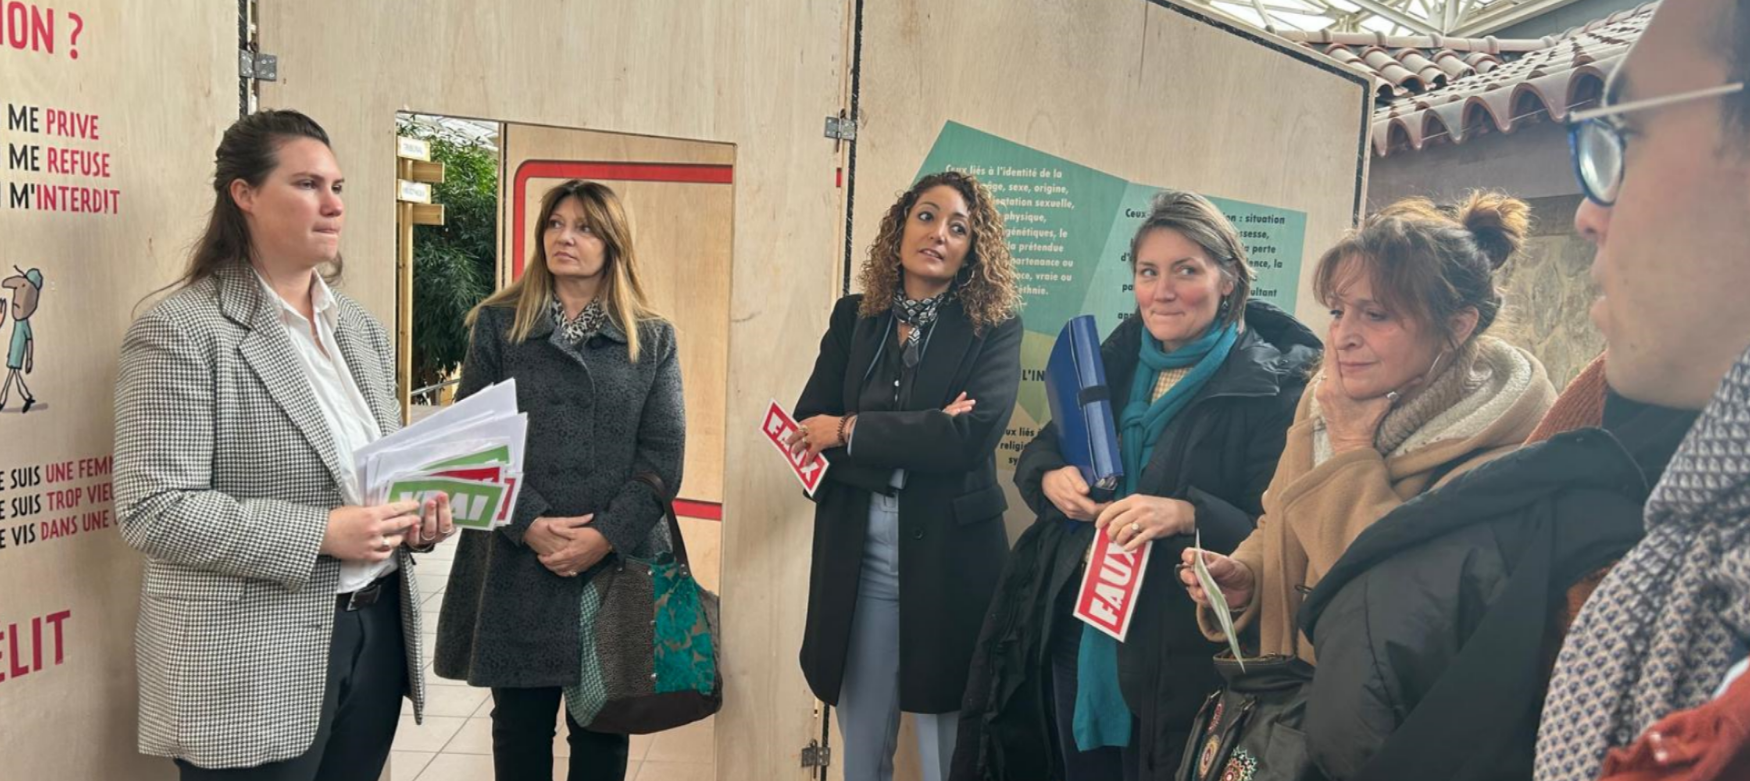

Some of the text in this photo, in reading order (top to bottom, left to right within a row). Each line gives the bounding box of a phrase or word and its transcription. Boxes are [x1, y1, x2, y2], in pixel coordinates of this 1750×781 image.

[68, 12, 83, 59] ?
[8, 103, 99, 140] ME PRIVE
[9, 143, 110, 178] ME REFUSE
[997, 166, 1037, 177] l'identité
[1039, 168, 1051, 178] de
[1053, 169, 1063, 178] la
[1008, 184, 1032, 193] sexe,
[1034, 183, 1069, 194] origine,
[10, 182, 120, 214] M'INTERDIT
[1035, 199, 1075, 209] sexuelle,
[1004, 211, 1047, 223] physique,
[1245, 213, 1286, 224] situation
[1059, 228, 1068, 238] le
[1018, 242, 1064, 252] prétendue
[1252, 245, 1277, 255] perte
[1062, 259, 1074, 267] ou
[1273, 259, 1283, 268] la
[1035, 271, 1058, 281] vraie
[1060, 274, 1072, 282] ou
[10, 465, 41, 489] SUIS
[45, 461, 74, 483] UNE
[11, 494, 41, 518] SUIS
[46, 487, 82, 511] TROP
[11, 523, 36, 546] VIS
[41, 515, 78, 541] DANS
[83, 509, 109, 532] UNE
[1089, 542, 1138, 627] FAUX
